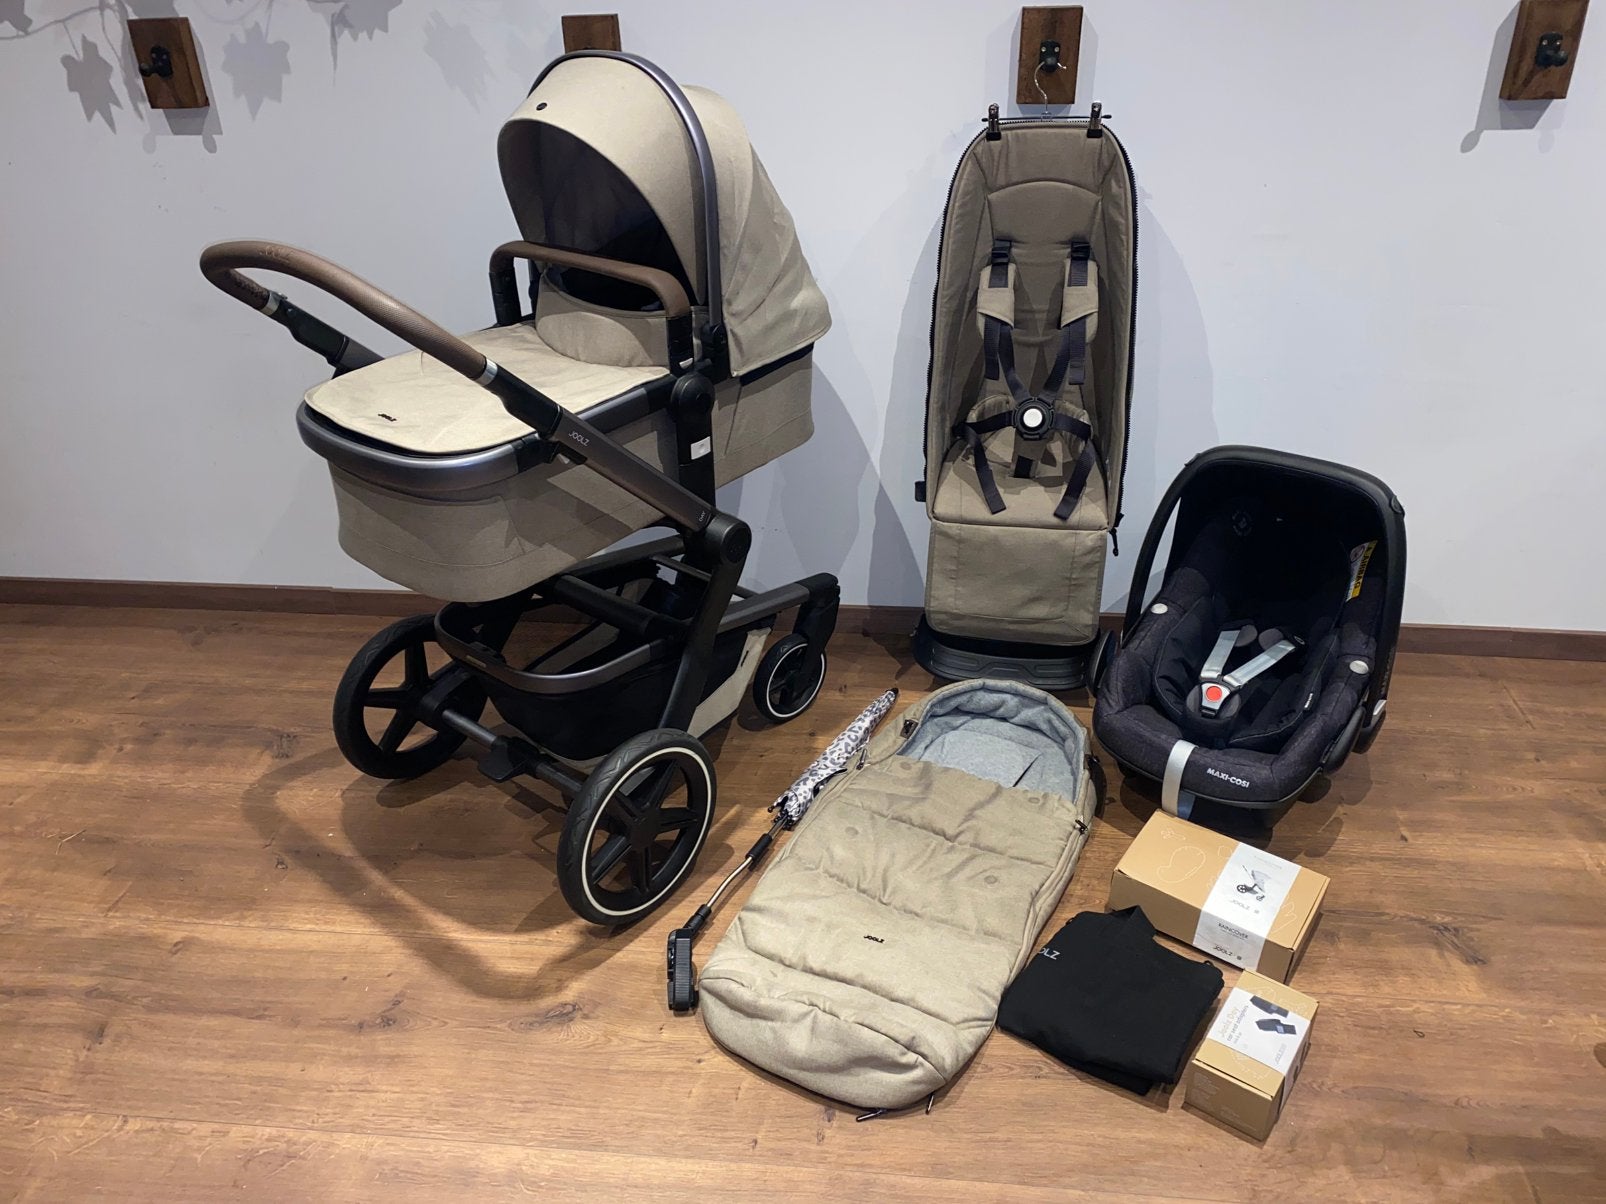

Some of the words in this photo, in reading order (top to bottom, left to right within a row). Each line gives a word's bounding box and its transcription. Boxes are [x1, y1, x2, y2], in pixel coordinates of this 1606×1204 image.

[569, 431, 590, 447] JOOLZ
[1207, 767, 1250, 788] MAXI-COSI
[1218, 922, 1249, 939] RAINCOVER
[1213, 945, 1233, 956] JOOLZ
